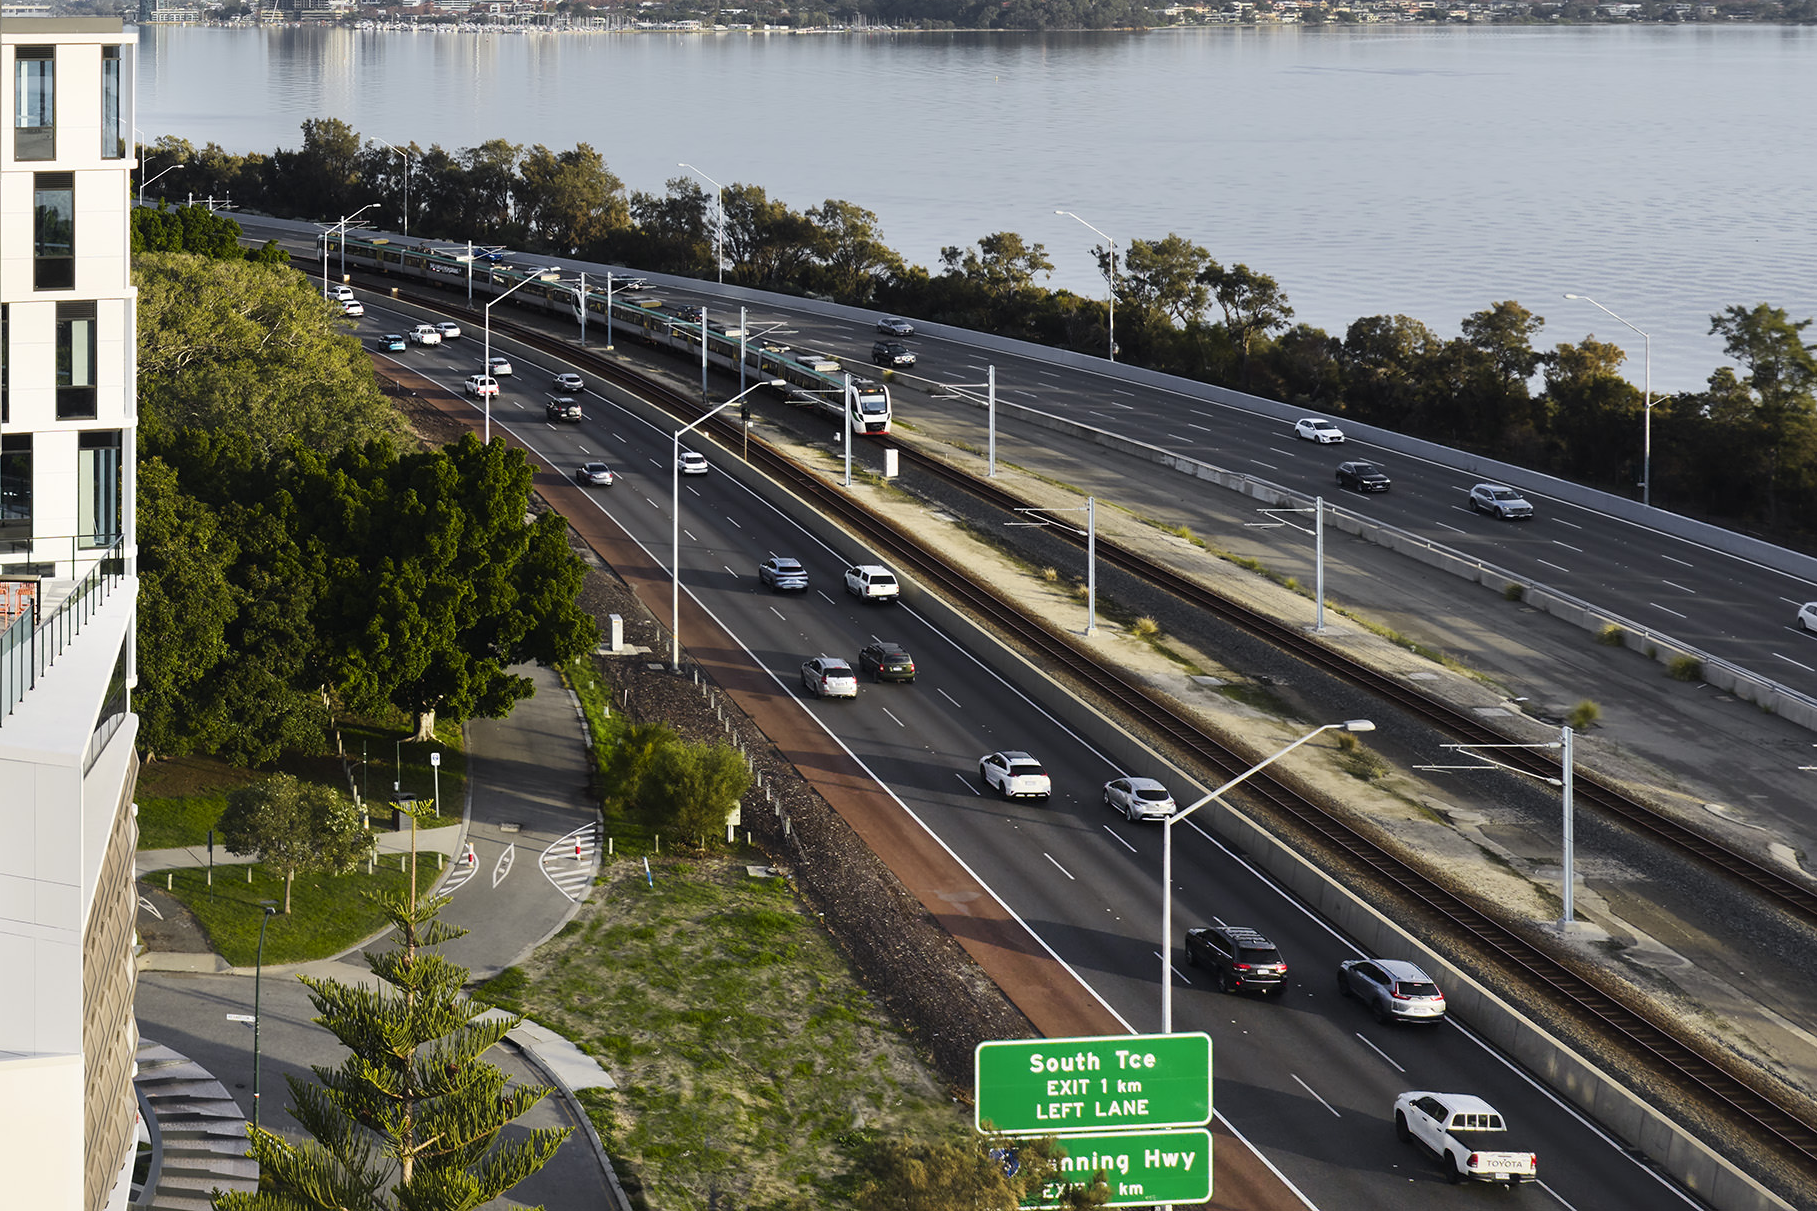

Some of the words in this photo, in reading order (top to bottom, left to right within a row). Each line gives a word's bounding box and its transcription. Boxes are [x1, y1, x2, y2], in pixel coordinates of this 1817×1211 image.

[1029, 1051, 1101, 1074] South
[1114, 1049, 1158, 1070] Tce
[1046, 1078, 1091, 1097] EXIT
[1100, 1077, 1108, 1094] 1
[1116, 1078, 1143, 1094] km
[1036, 1101, 1085, 1120] LEFT
[1094, 1098, 1150, 1118] LANE
[1042, 1151, 1130, 1175] nning
[1144, 1148, 1196, 1172] Hwy
[1487, 1160, 1523, 1168] TOYOTA
[1118, 1181, 1144, 1196] km
